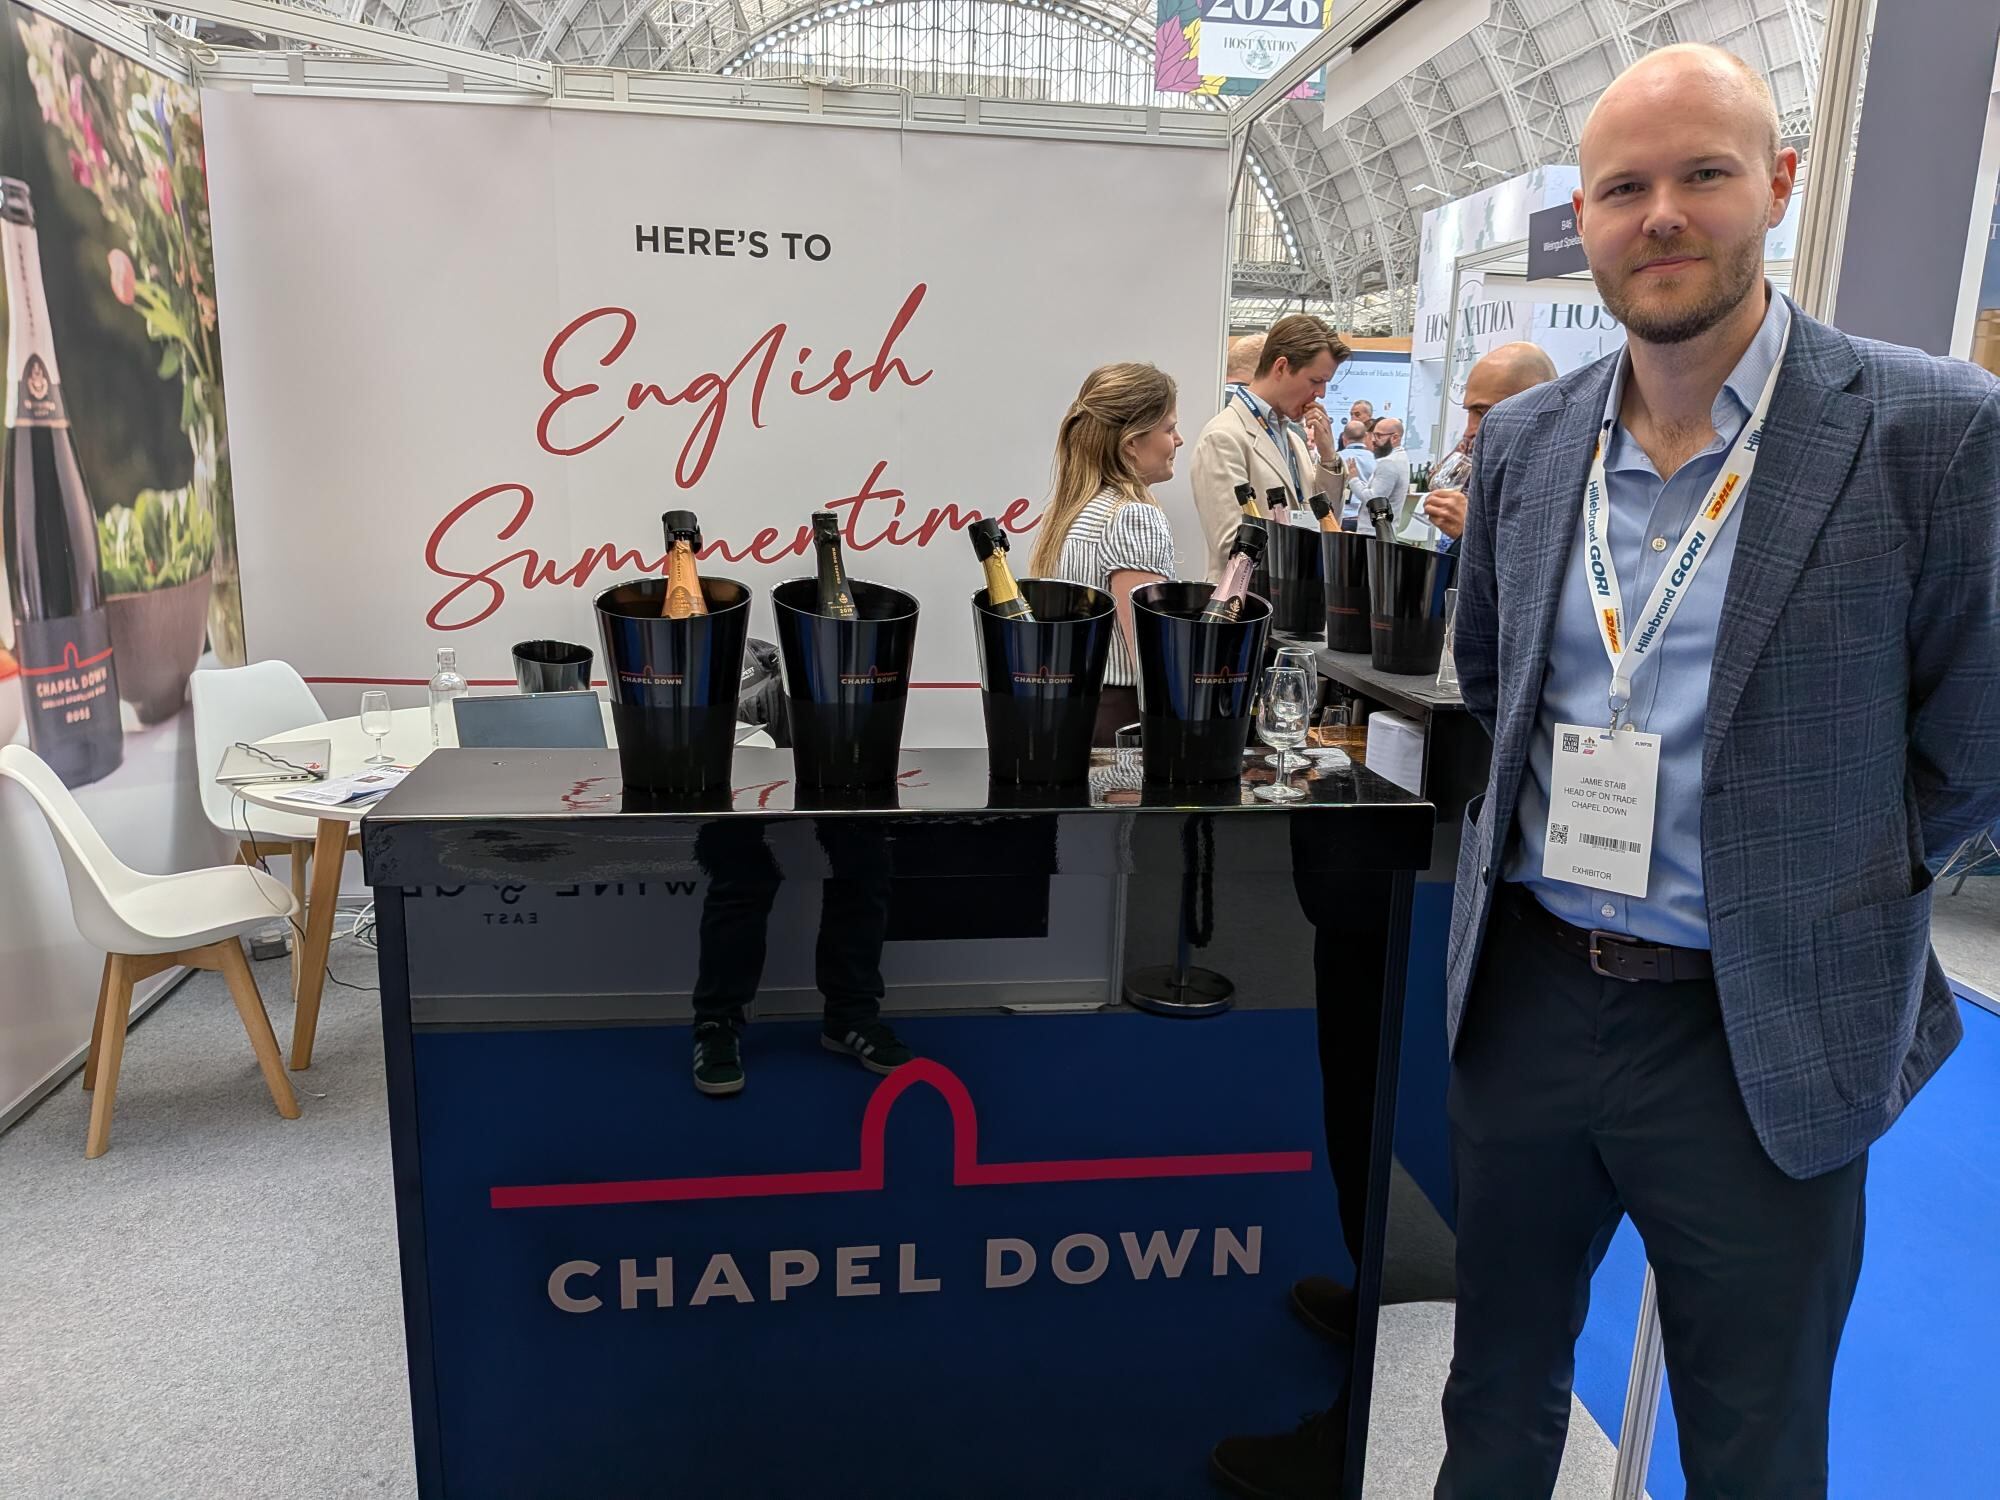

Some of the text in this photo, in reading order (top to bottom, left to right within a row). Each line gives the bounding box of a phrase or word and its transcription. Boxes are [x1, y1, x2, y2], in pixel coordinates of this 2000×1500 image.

[1206, 0, 1320, 25] 2026
[1223, 36, 1299, 53] HOST NATION
[781, 232, 832, 262] TO
[1424, 300, 1515, 344] HOS NATION
[1547, 303, 1619, 331] HOS
[536, 282, 935, 489] English
[1588, 480, 1611, 597] Hillebrand GORI
[1635, 531, 1706, 654] Hillebrand GORI
[36, 676, 80, 698] CHAPEL
[81, 666, 107, 689] DOWN
[621, 675, 653, 685] CHAPEL
[840, 676, 897, 685] CHAPEL DOWN
[1014, 676, 1047, 684] CHAPEL
[1228, 676, 1248, 684] DOWN
[1580, 777, 1627, 790] JAMIE STAIB
[1564, 787, 1638, 805] HEAD OF ON TRADE
[1571, 800, 1628, 816] CHAPEL DOWN
[1571, 865, 1613, 881] EXHIBITOR
[547, 1225, 1263, 1315] CHAPEL DOWN
